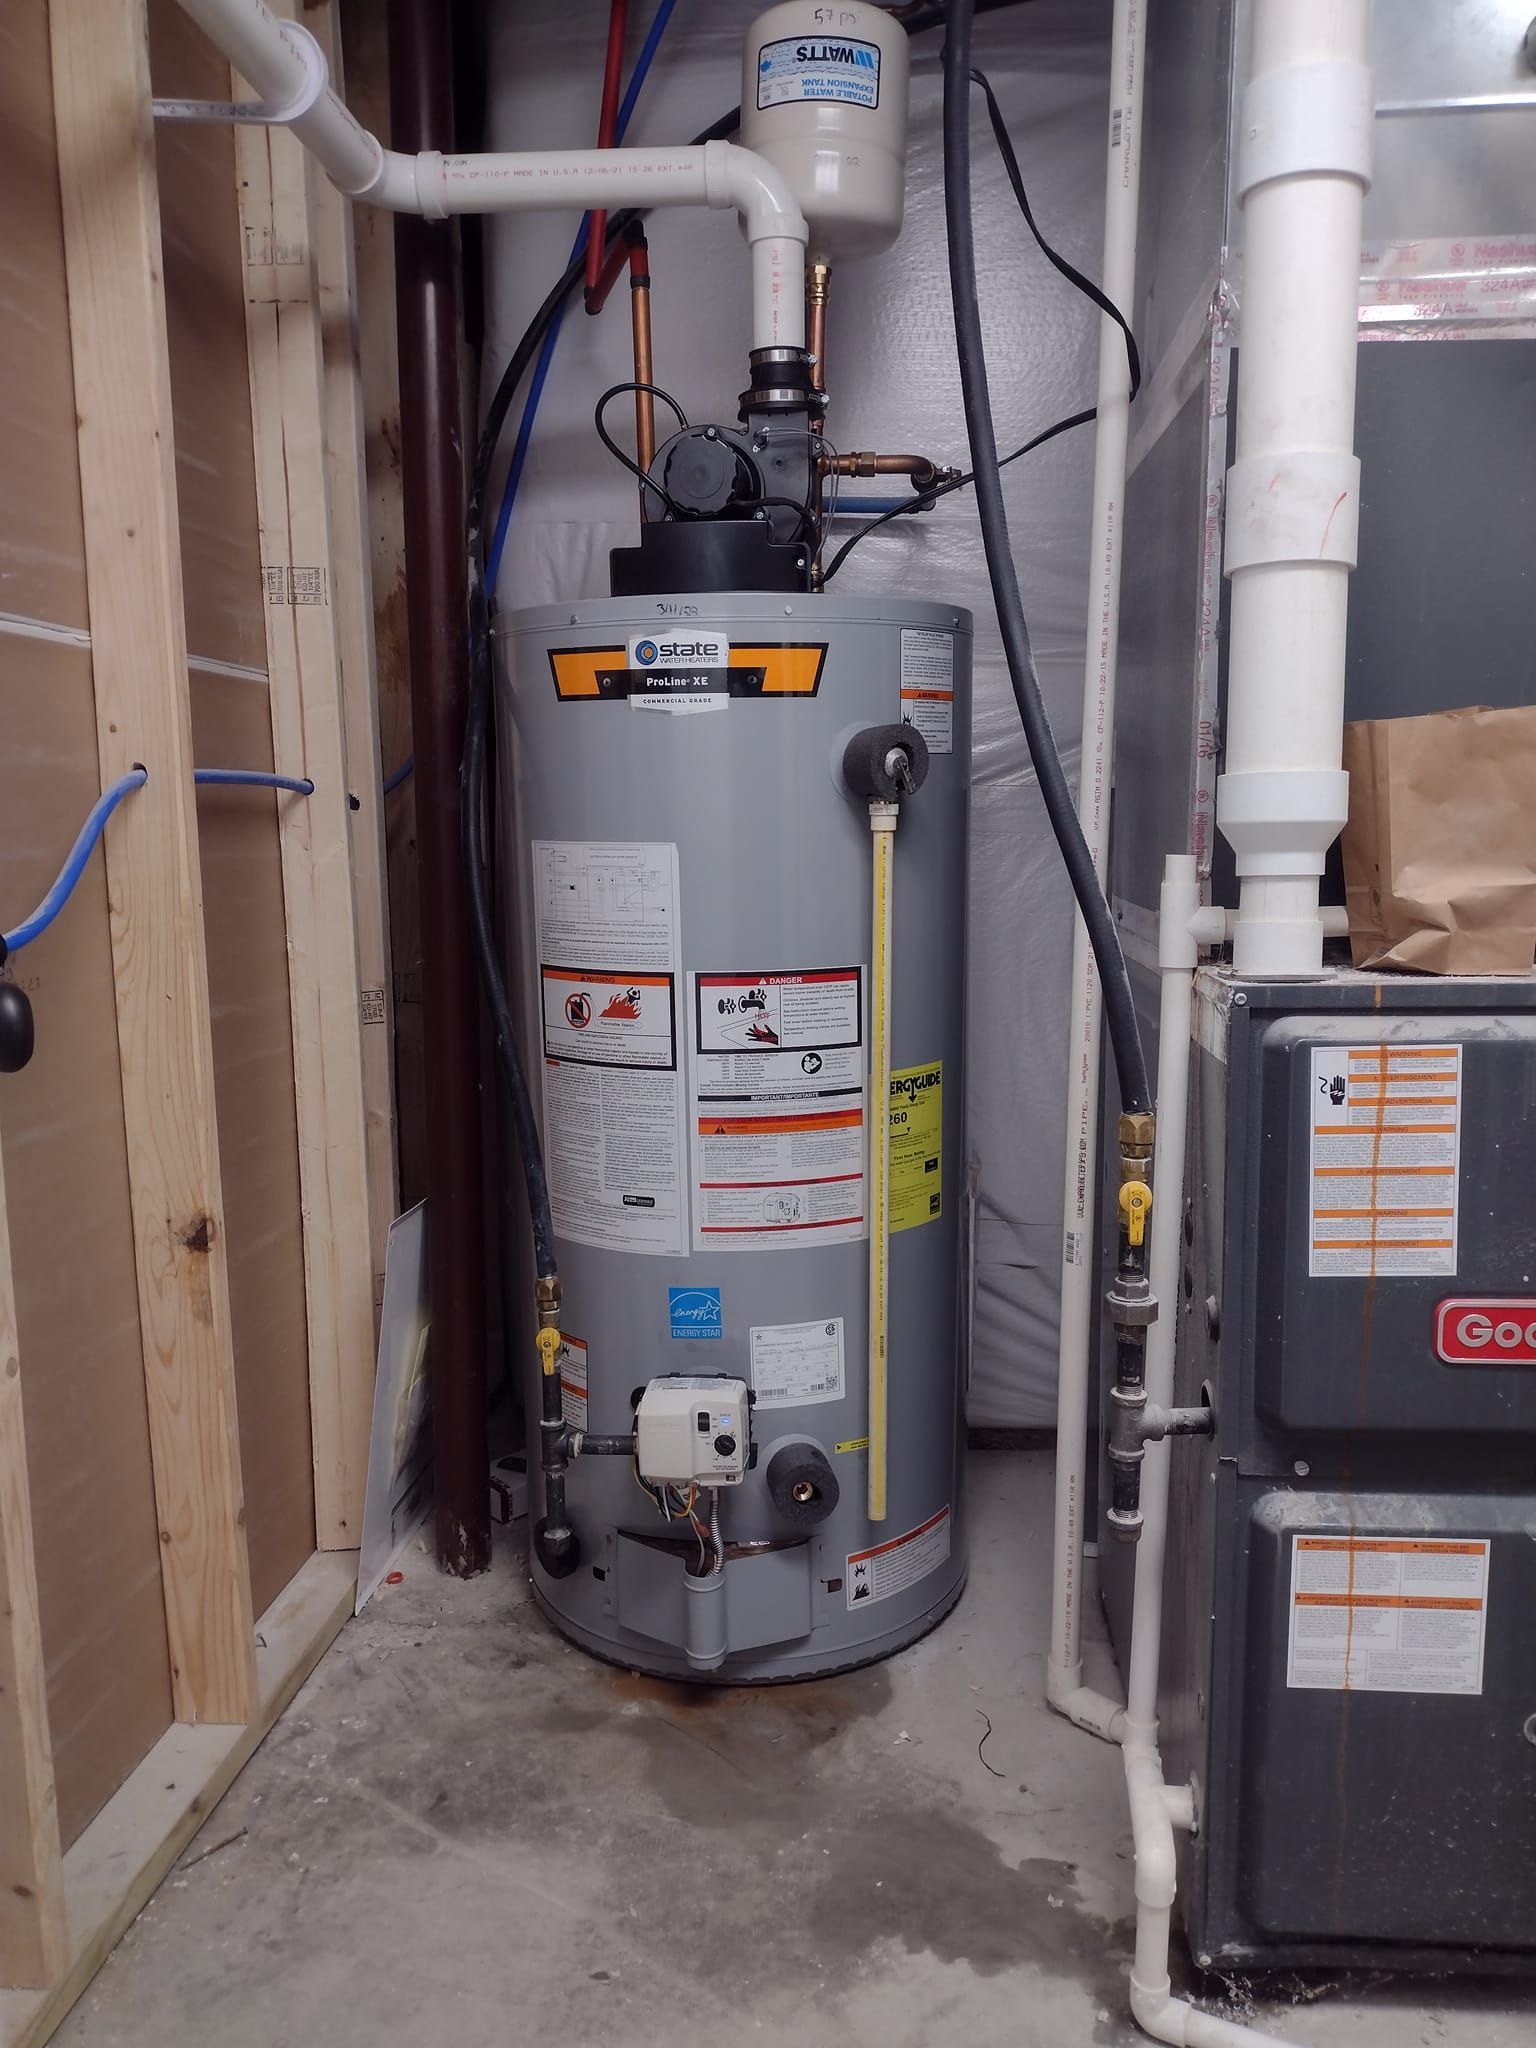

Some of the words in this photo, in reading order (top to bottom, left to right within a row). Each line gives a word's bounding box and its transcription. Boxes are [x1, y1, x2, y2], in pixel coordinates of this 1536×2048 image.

[796, 46, 855, 65] WATTS
[801, 78, 827, 87] TANK
[826, 79, 874, 94] EXPANSION
[803, 87, 834, 97] WATER
[835, 89, 873, 103] POTABLE
[1481, 279, 1520, 293] 324A
[659, 641, 719, 657] state
[693, 676, 708, 686] XE
[586, 976, 616, 984] WARNING
[769, 976, 803, 985] DANGER
[672, 1328, 701, 1337] ENERGY
[701, 1328, 721, 1337] STAR
